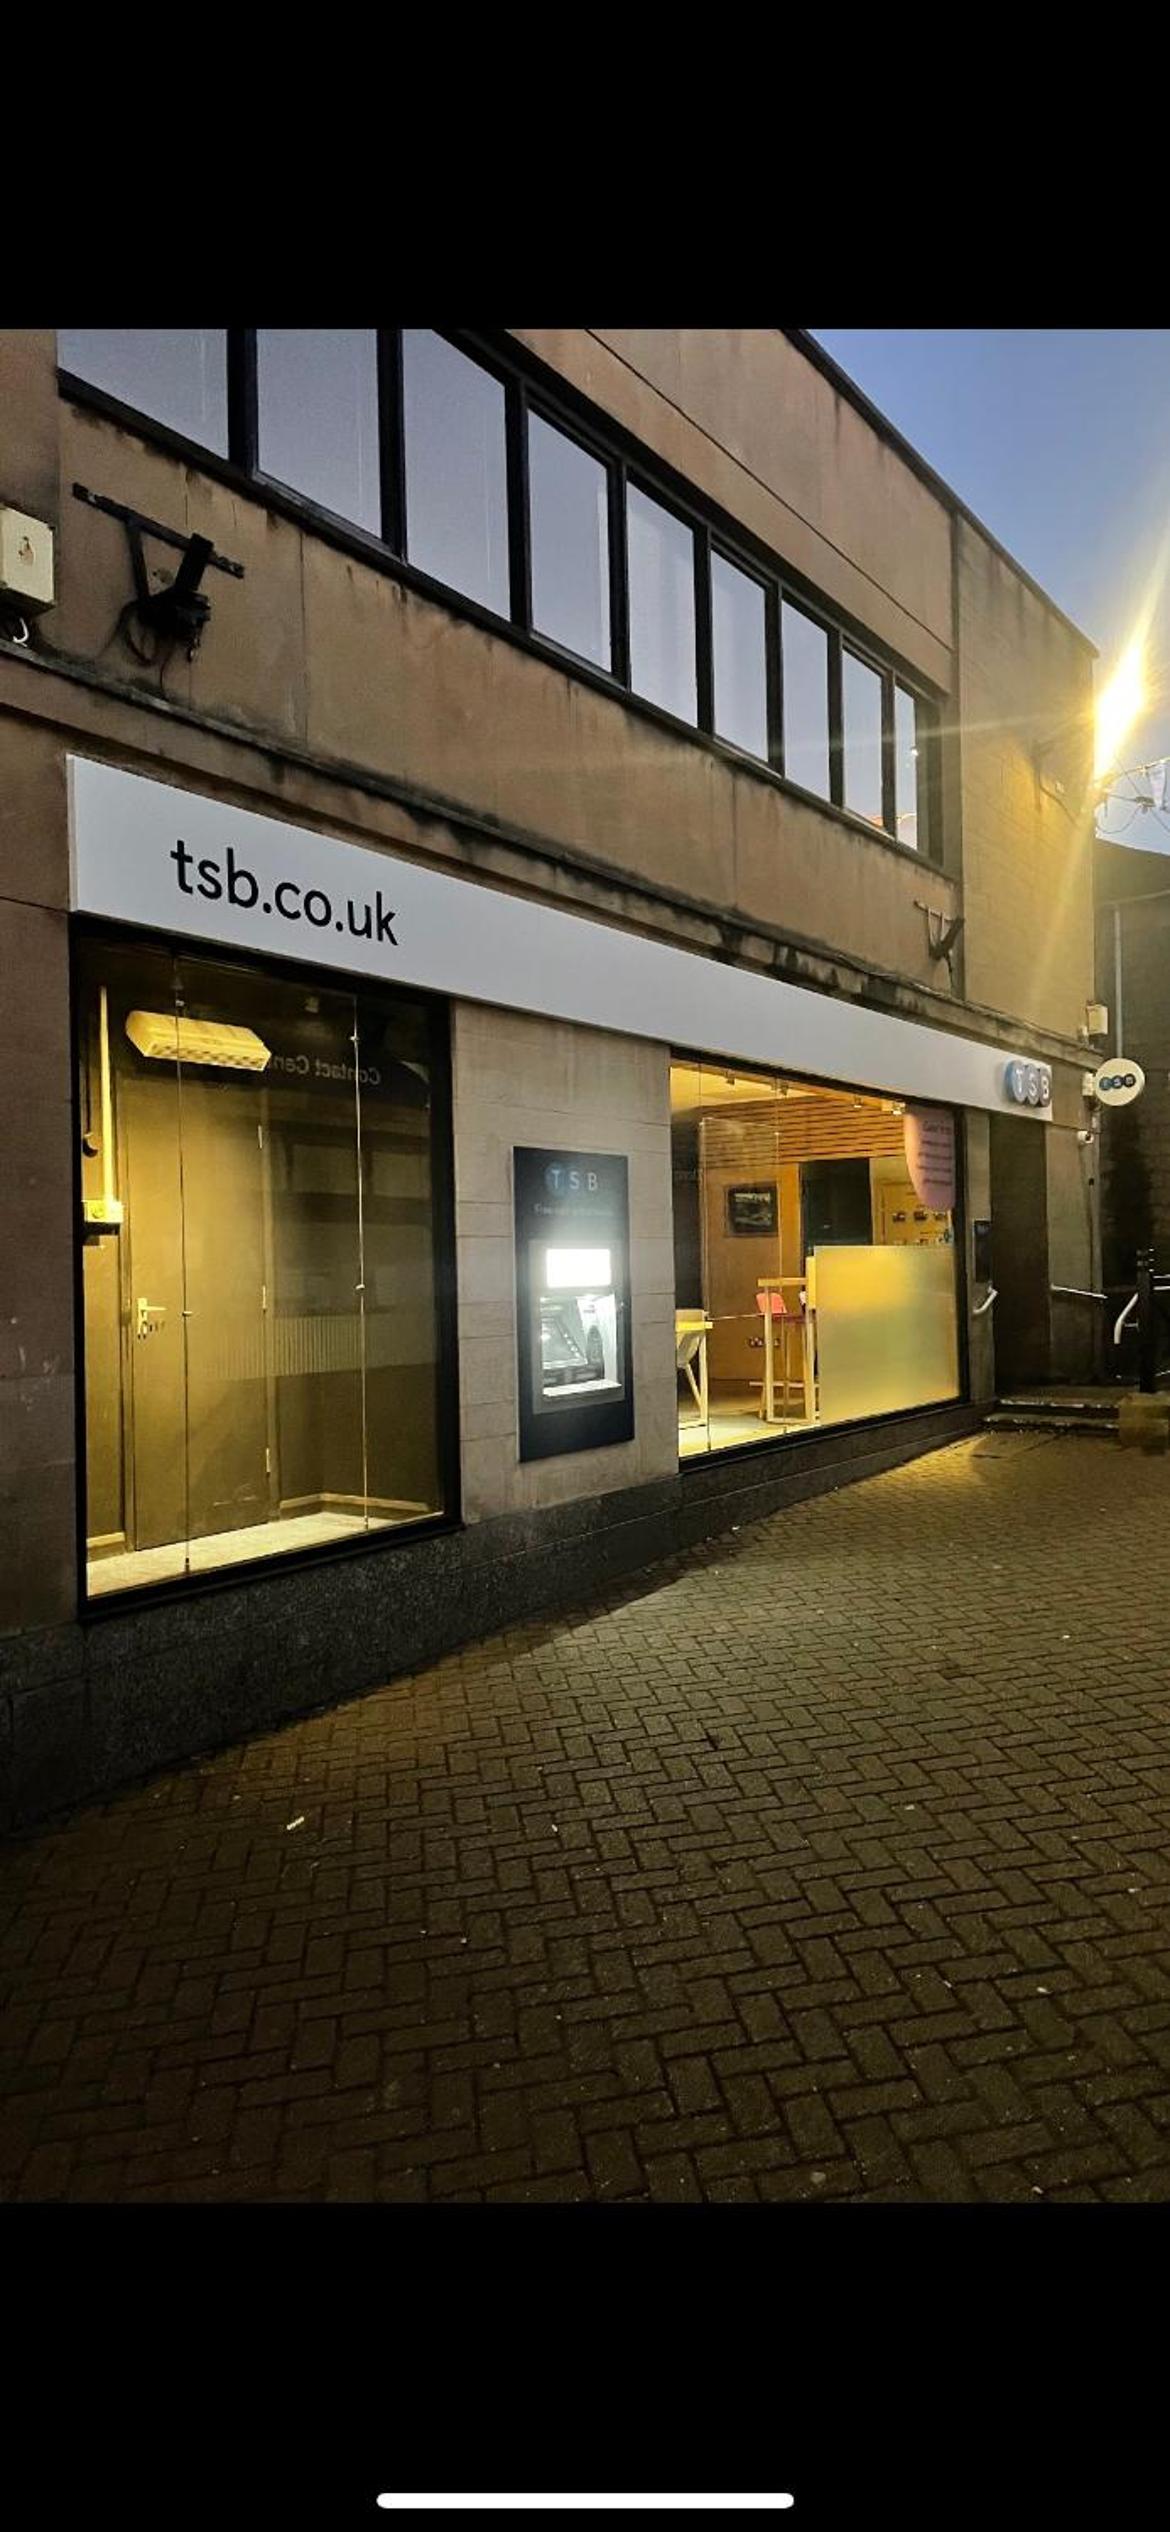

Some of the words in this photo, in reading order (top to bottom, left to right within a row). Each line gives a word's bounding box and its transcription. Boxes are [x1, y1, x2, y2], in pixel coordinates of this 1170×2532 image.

[170, 839, 398, 946] tsb.co.uk
[1012, 1066, 1050, 1101] TSB
[551, 1169, 599, 1191] TSB
